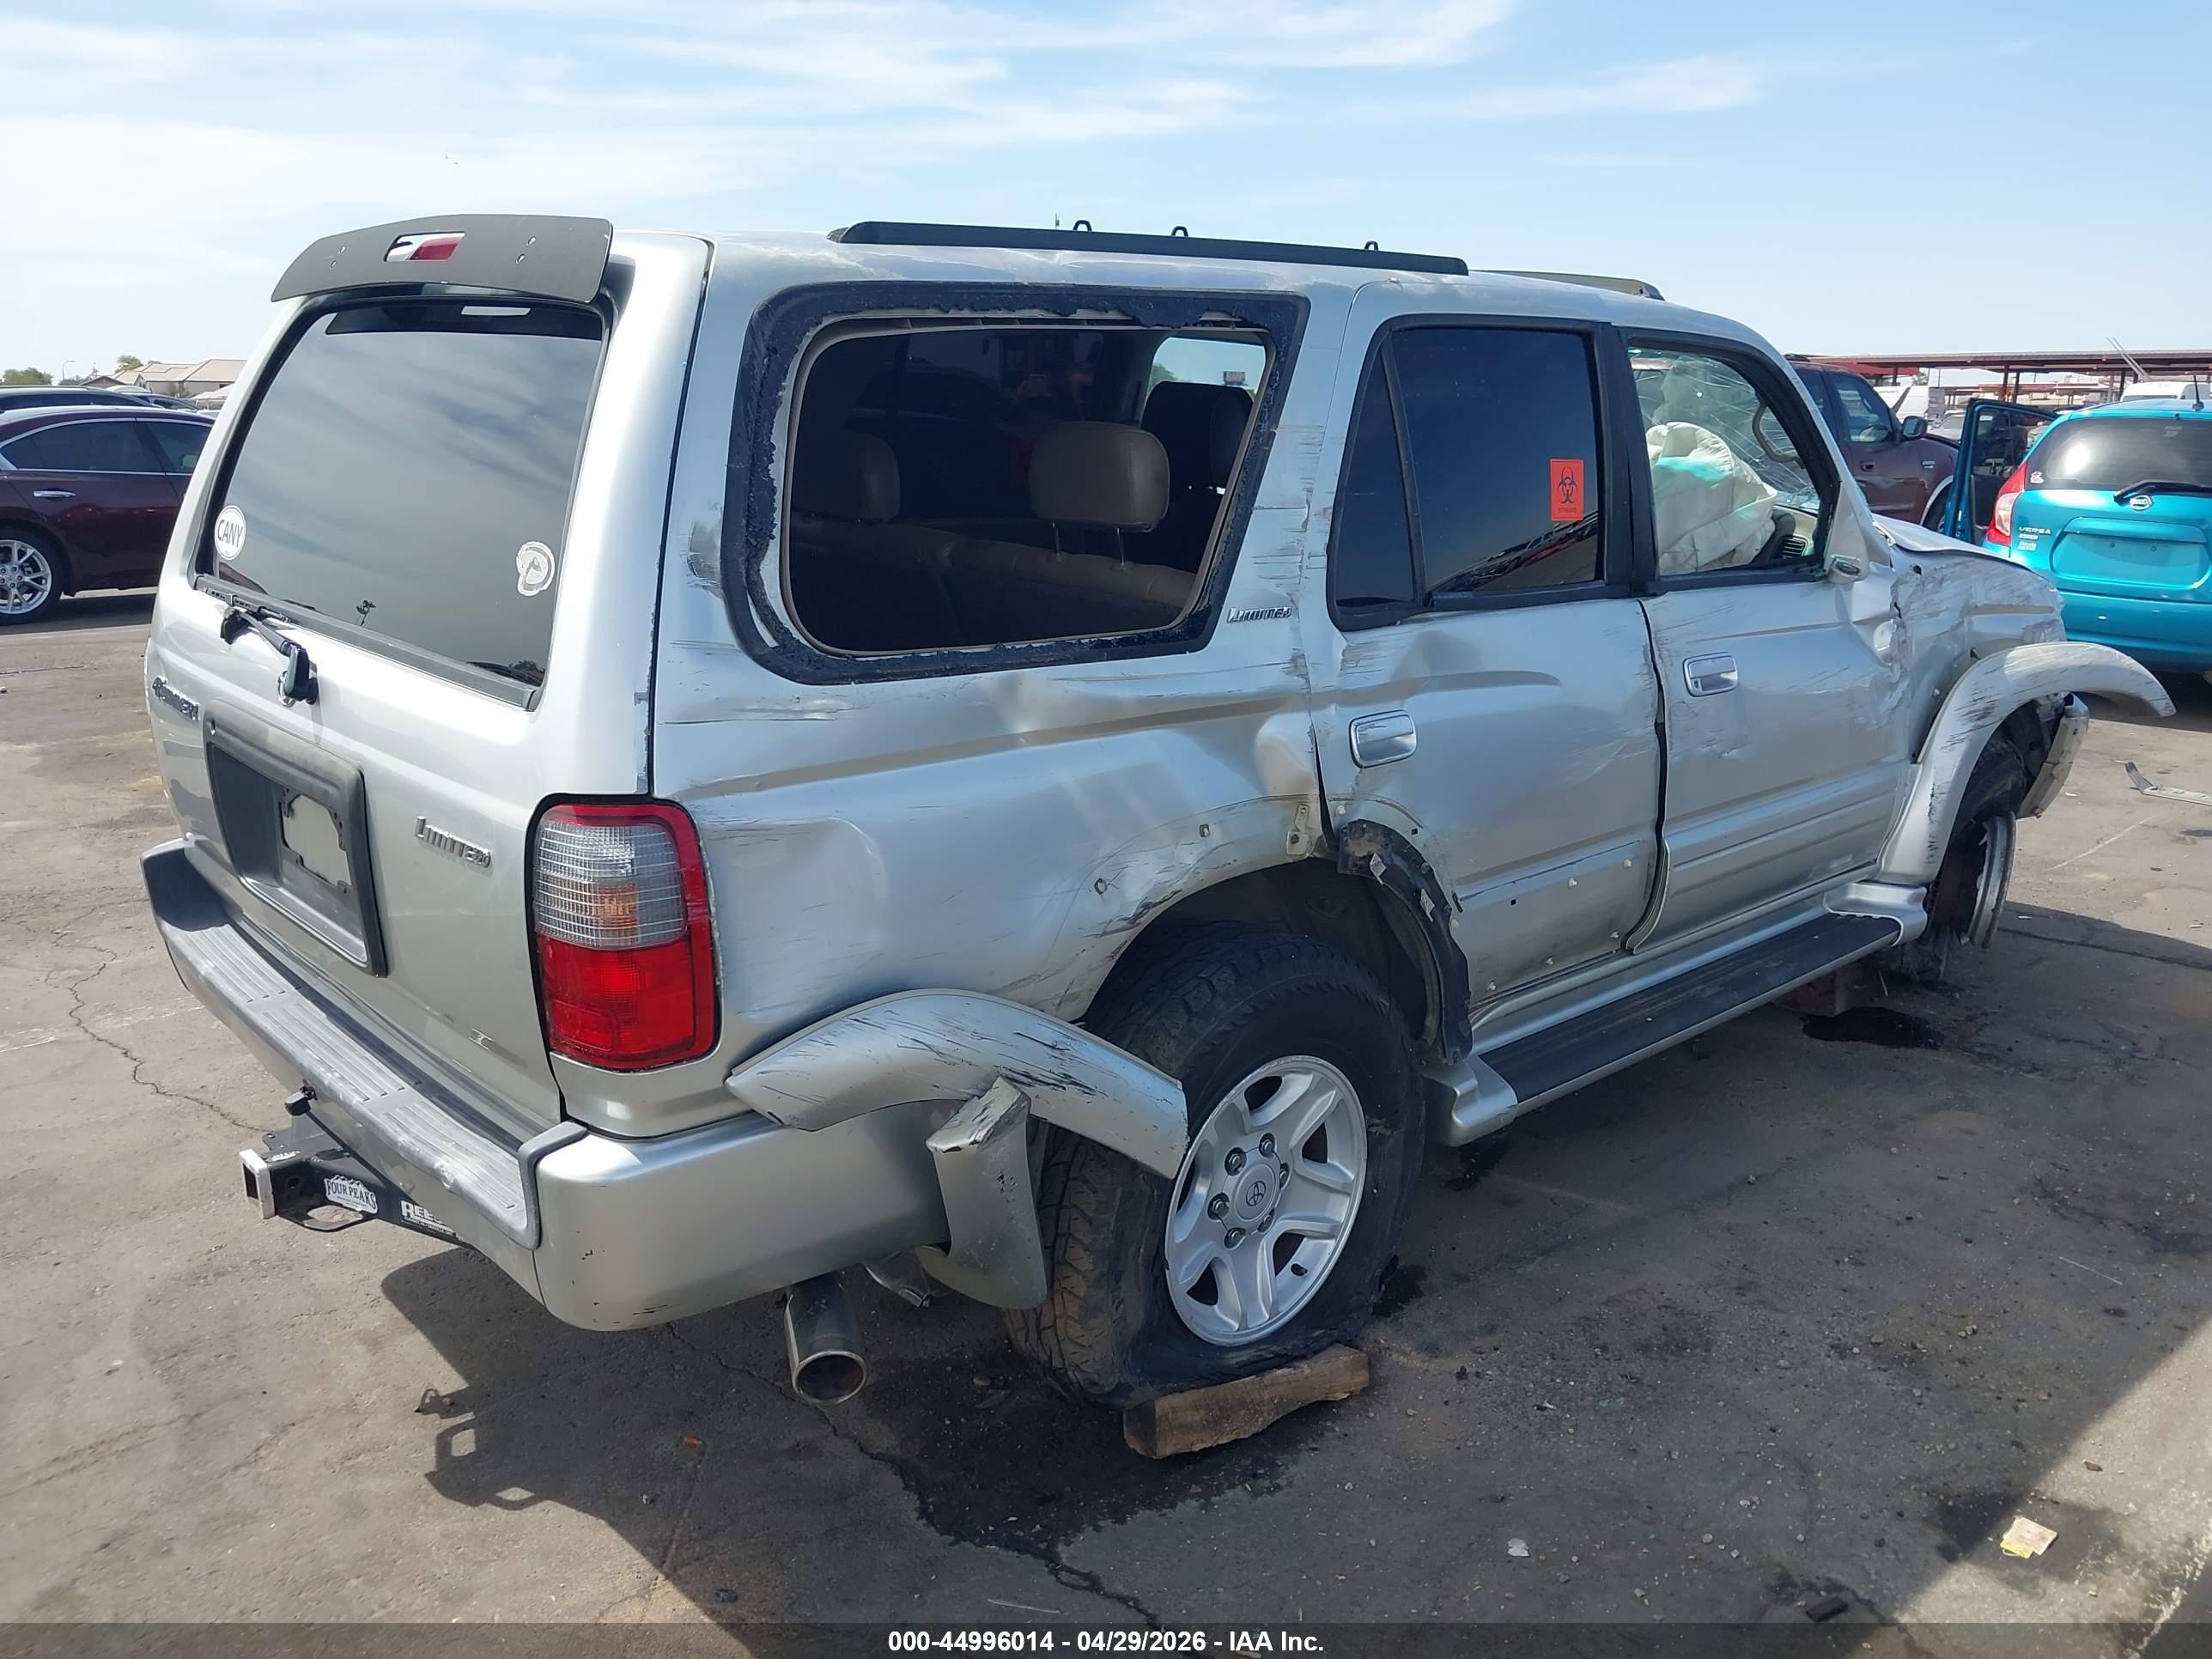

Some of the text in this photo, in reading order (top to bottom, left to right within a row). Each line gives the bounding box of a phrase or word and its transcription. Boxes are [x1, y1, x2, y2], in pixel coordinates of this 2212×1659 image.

[217, 519, 244, 548] CANY
[2019, 526, 2051, 535] VERSA
[326, 1180, 348, 1196] FOUR
[348, 1186, 377, 1210] PEAKS
